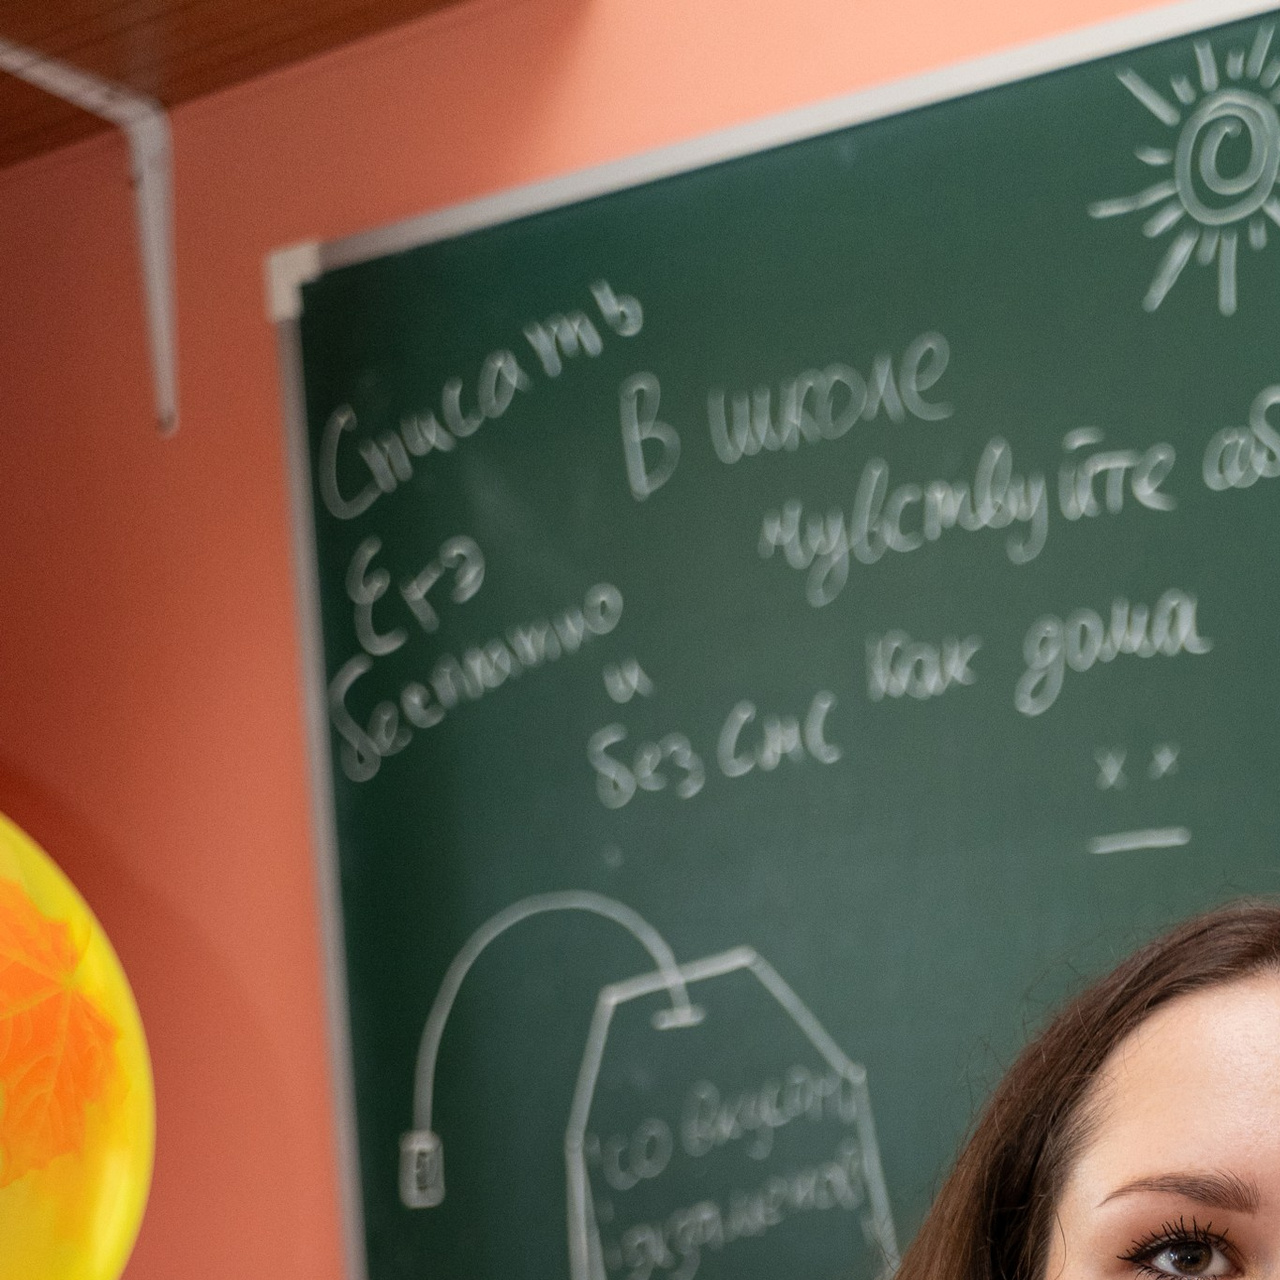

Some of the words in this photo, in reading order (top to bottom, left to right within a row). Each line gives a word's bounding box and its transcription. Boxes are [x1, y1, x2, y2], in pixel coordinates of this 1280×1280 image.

[318, 277, 645, 520] Списать
[705, 330, 955, 465] школе
[1014, 586, 1214, 716] дома
